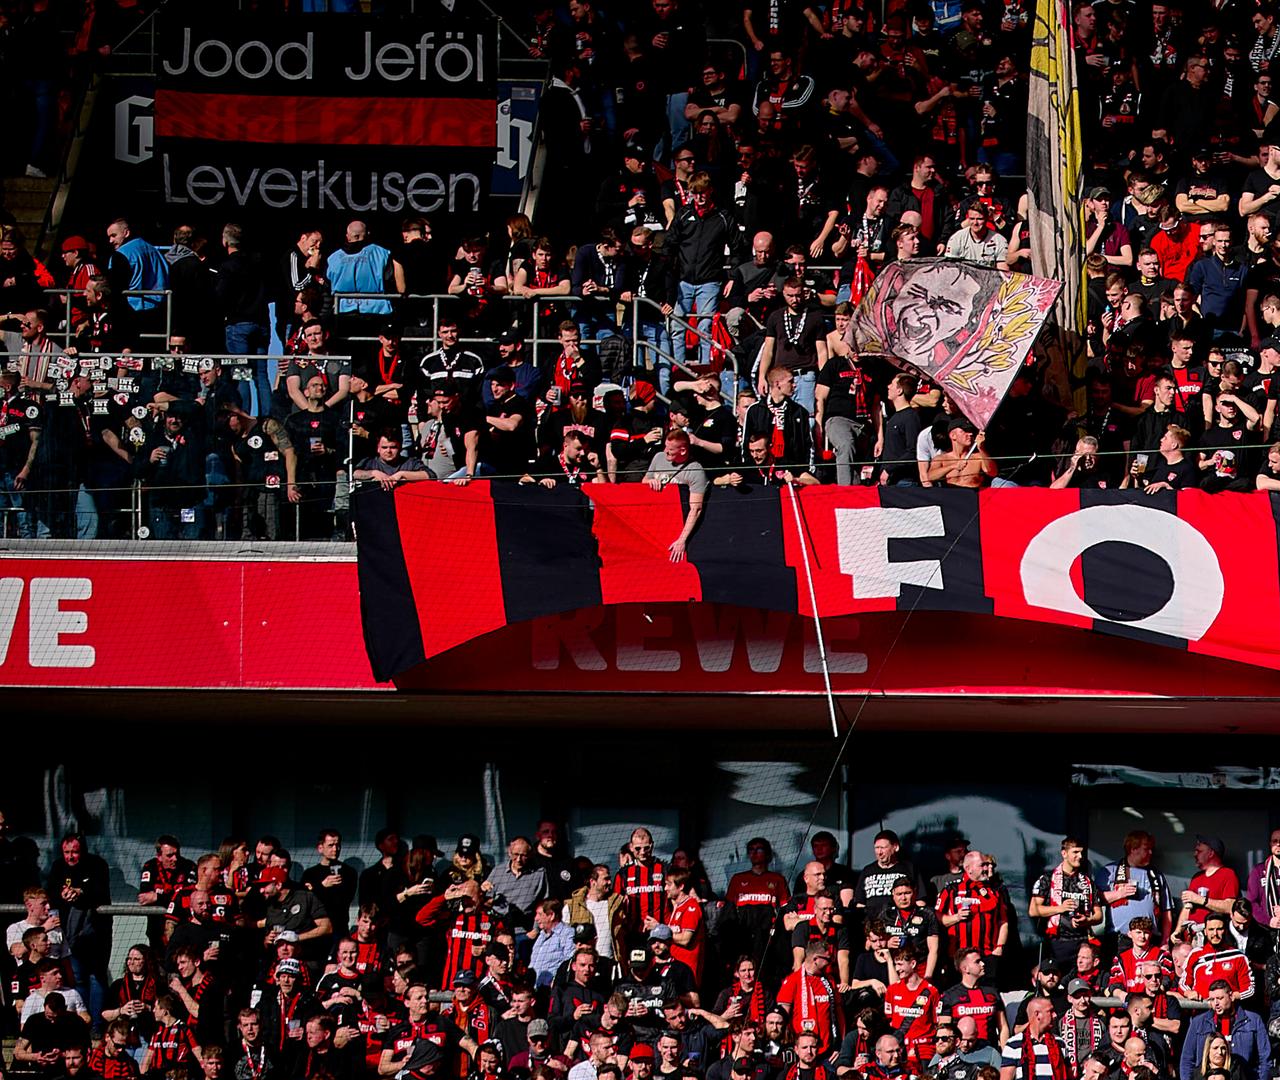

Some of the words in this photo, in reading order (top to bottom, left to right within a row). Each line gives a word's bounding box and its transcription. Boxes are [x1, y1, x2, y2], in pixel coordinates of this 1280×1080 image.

[162, 27, 313, 80] Jood
[345, 31, 483, 82] Jeföl
[163, 153, 480, 212] Leverkusen
[739, 891, 778, 902] Barmena
[894, 1006, 926, 1016] Barmenia
[958, 1005, 994, 1016] Barmen
